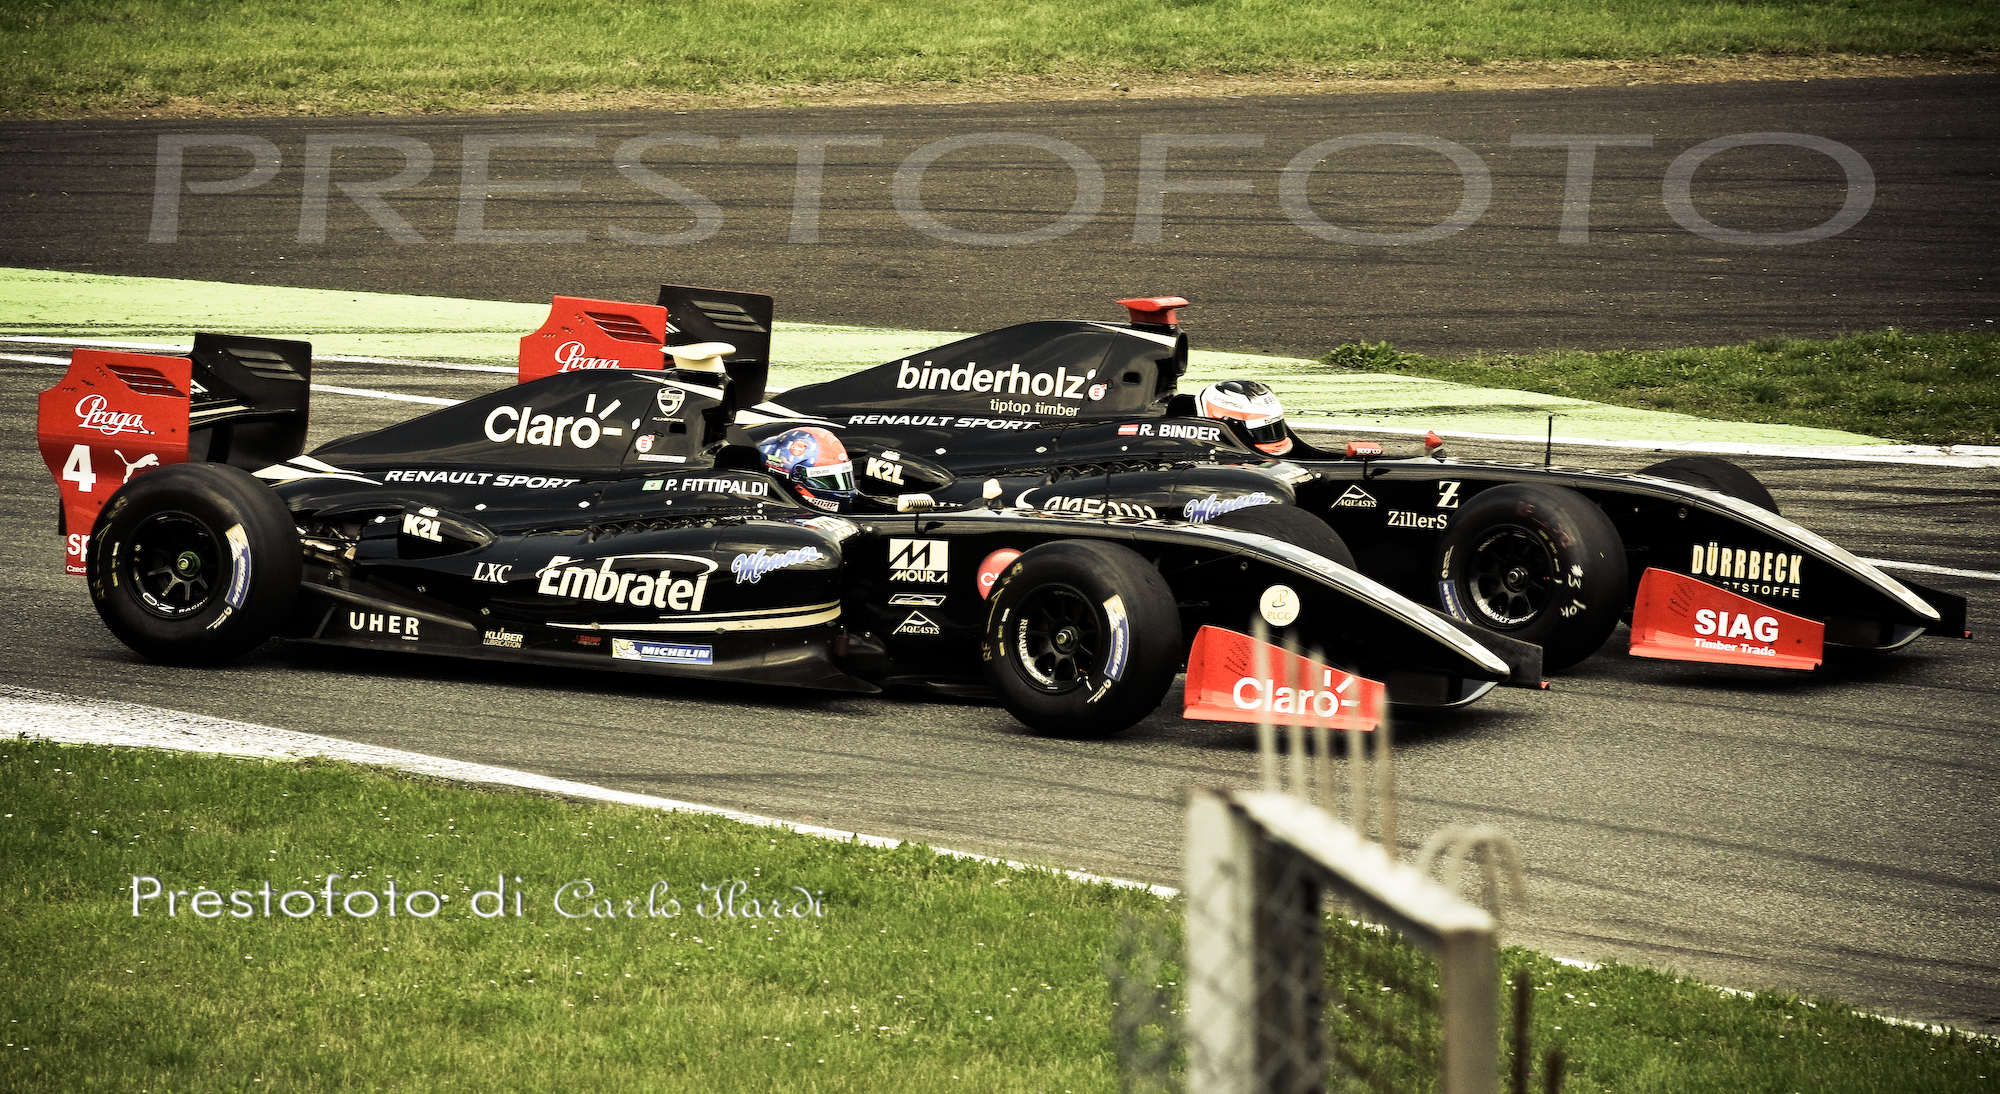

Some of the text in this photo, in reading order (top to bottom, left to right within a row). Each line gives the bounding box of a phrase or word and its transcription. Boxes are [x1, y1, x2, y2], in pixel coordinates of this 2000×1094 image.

[897, 359, 1087, 400] binderholz
[75, 394, 155, 435] Praga
[989, 398, 1080, 416] tiptop timber
[484, 405, 601, 449] Claro
[848, 414, 1040, 431] RENAULT SPORT
[1138, 423, 1221, 441] R. BINDER
[62, 444, 96, 492] 4
[866, 457, 905, 486] K2L
[384, 470, 580, 489] RENAULT SPORT
[664, 479, 769, 497] P. FITTIPALDI
[403, 513, 442, 542] K2L
[1387, 510, 1448, 530] ZillerS
[472, 562, 512, 584] LXC
[1691, 541, 1803, 585] DÜRRBECK
[536, 554, 712, 612] Embratel
[889, 570, 948, 583] MOURA
[349, 612, 419, 635] UHER
[899, 625, 940, 635] AQUASYS
[1694, 608, 1780, 643] SIAG
[1018, 618, 1031, 661] RENAULT
[1694, 637, 1776, 657] Timber Trade
[640, 645, 710, 659] MICHELIN
